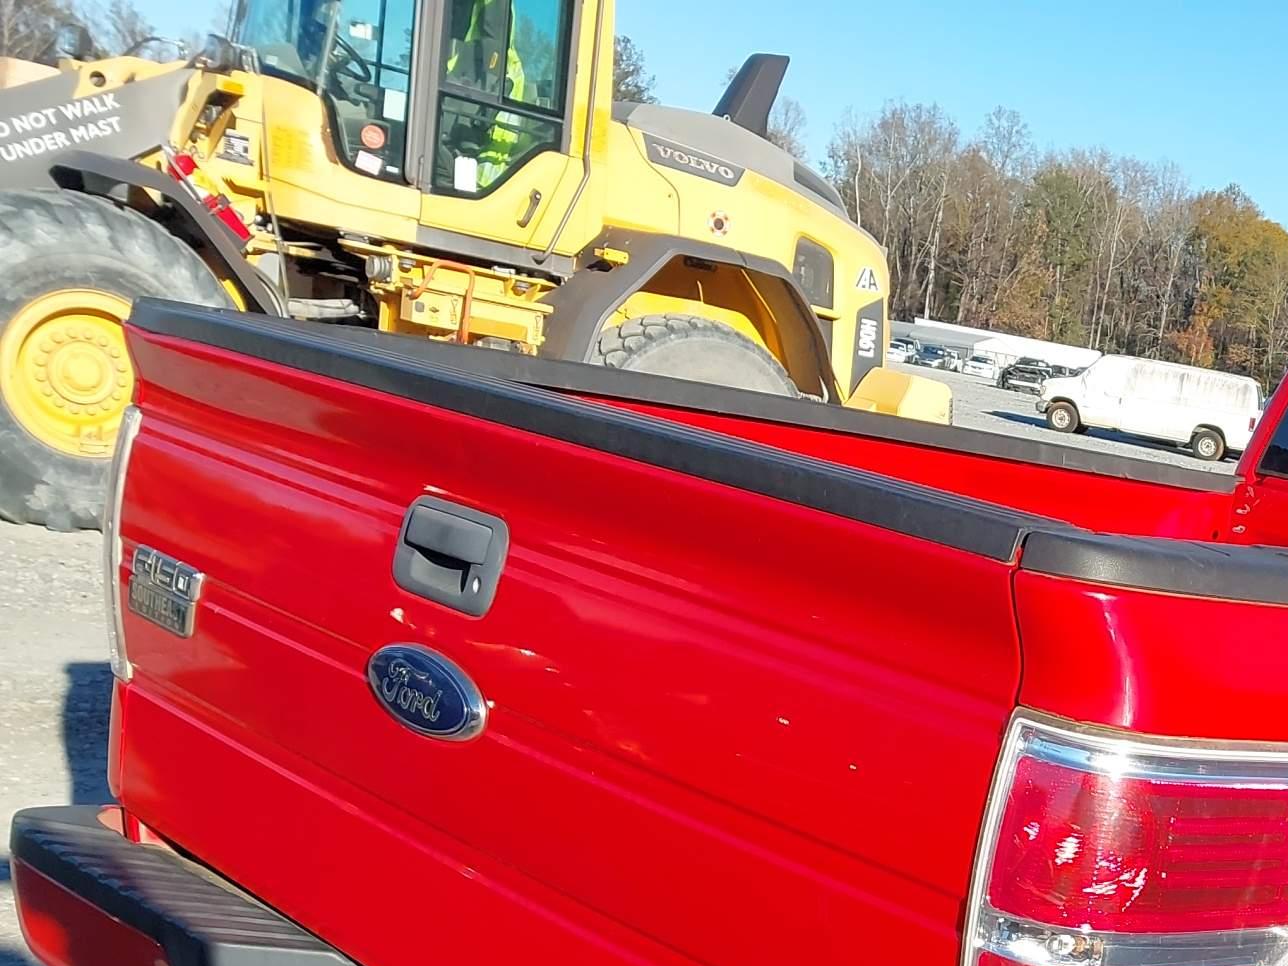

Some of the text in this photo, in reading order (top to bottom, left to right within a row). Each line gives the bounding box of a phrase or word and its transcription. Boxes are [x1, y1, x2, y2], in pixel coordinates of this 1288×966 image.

[10, 108, 57, 133] NOT
[58, 93, 120, 120] WALK
[0, 116, 120, 161] UNDER MAST
[651, 143, 735, 179] VOLVO
[858, 318, 878, 358] L90H
[383, 658, 443, 722] Ford
